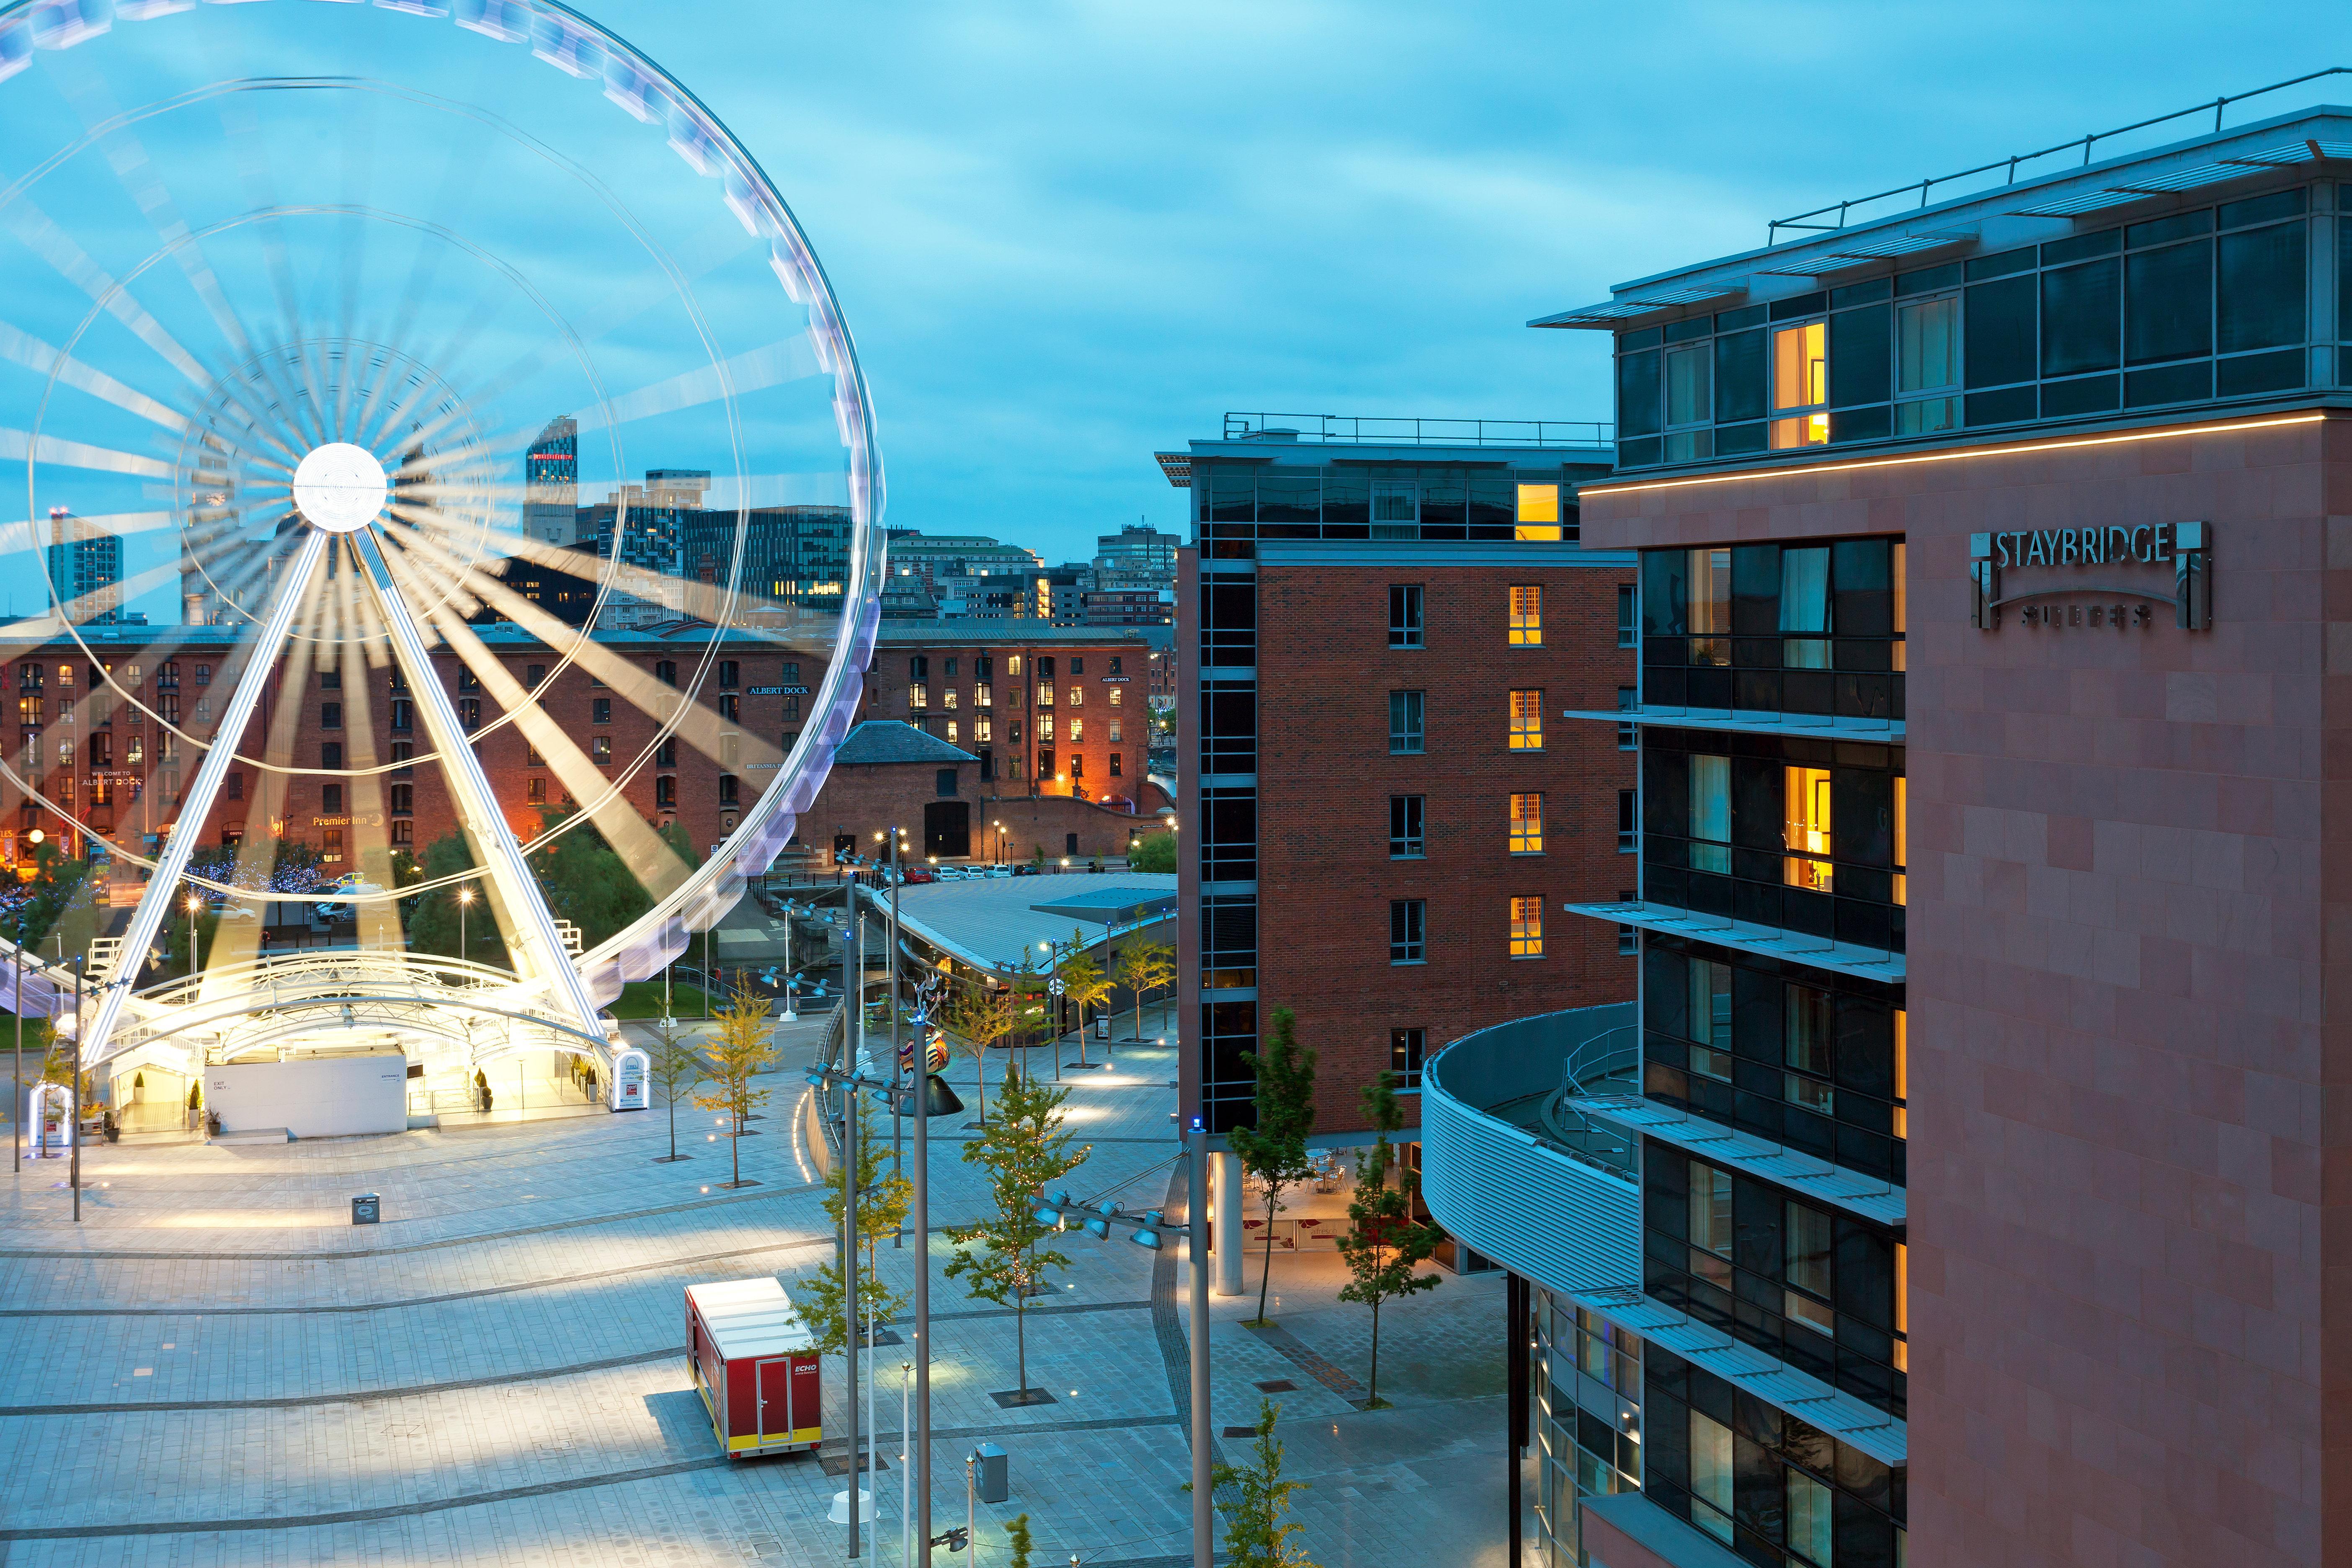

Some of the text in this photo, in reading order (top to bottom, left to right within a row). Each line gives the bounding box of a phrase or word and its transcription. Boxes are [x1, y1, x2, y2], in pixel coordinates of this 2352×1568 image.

[1996, 523, 2170, 568] STAYBRIDGE
[2021, 605, 2149, 627] SUITES
[313, 816, 367, 826] Premier Inn
